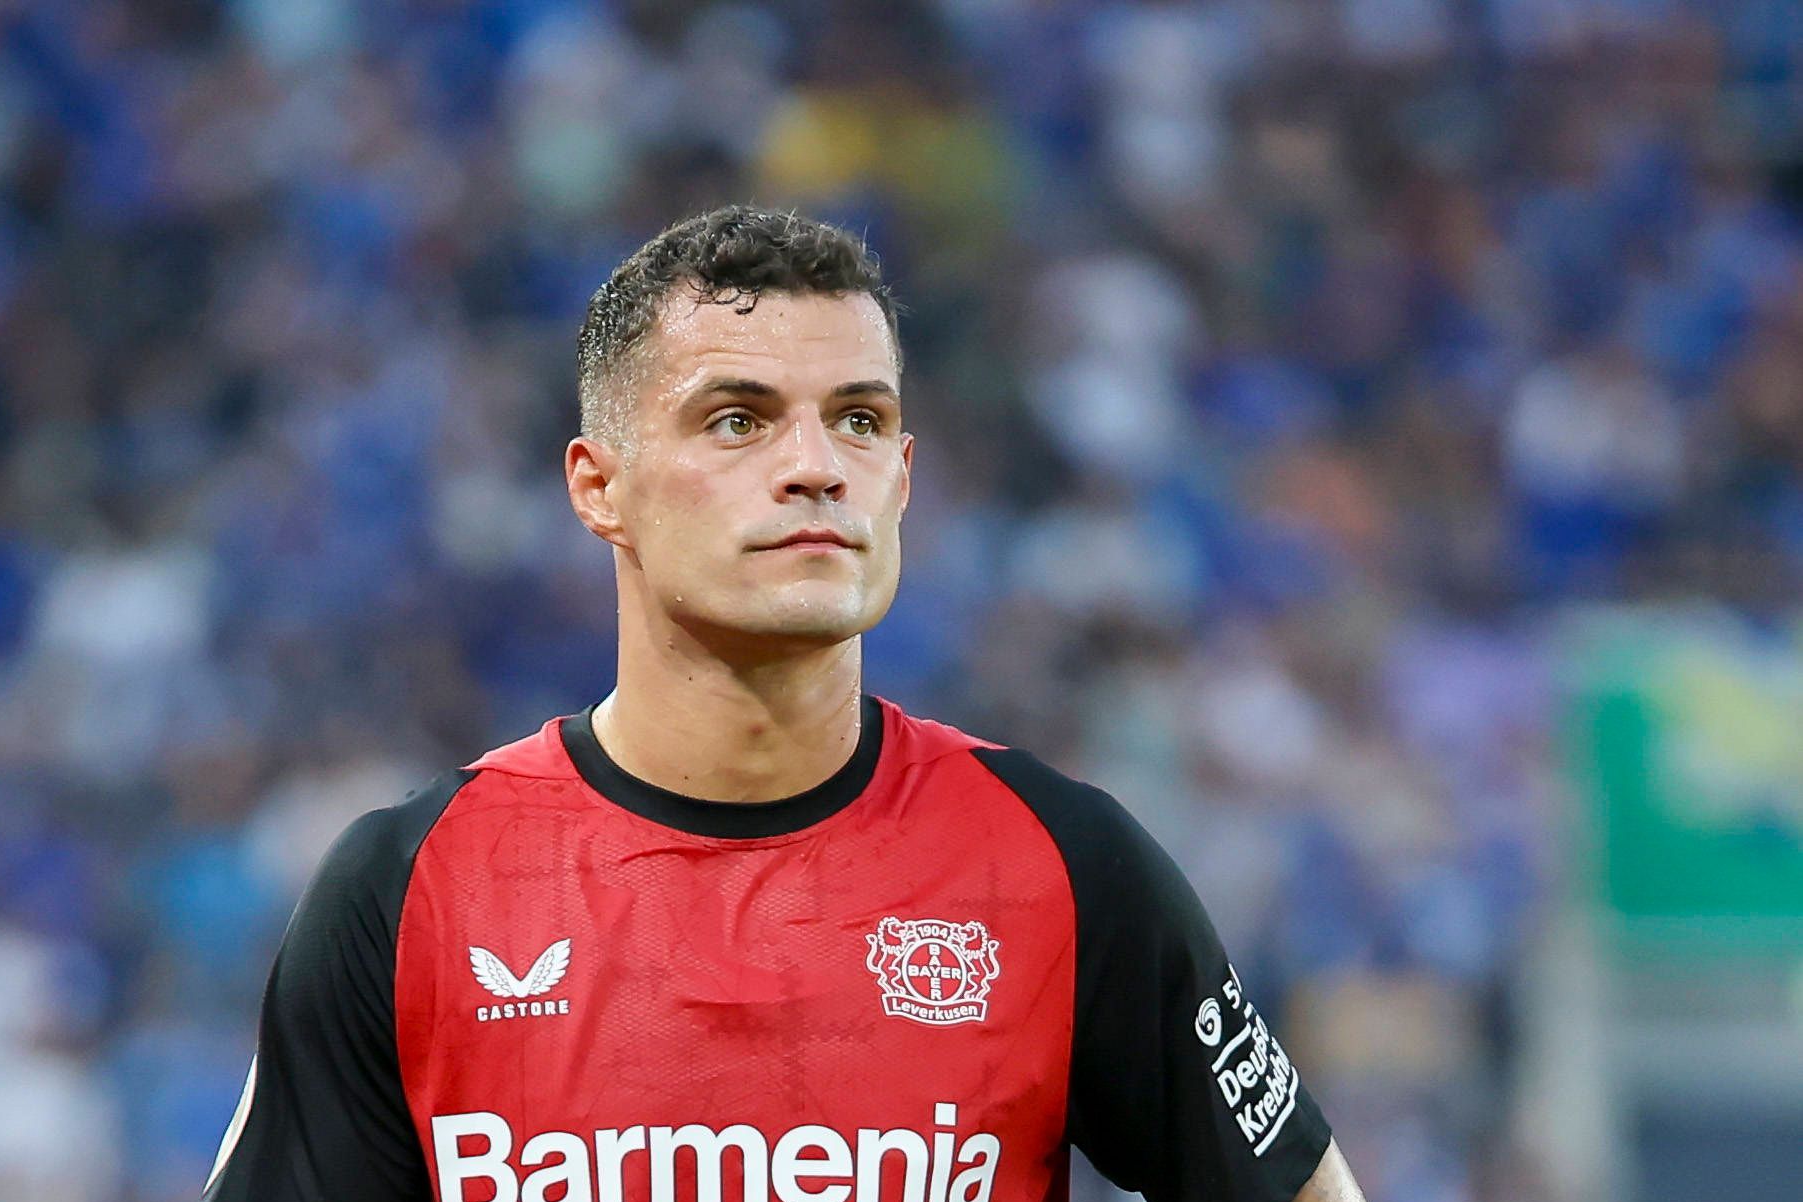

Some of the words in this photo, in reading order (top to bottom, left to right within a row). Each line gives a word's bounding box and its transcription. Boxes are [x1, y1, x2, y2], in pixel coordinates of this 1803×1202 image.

[917, 925, 950, 940] 1904
[907, 965, 963, 979] BAYER
[477, 999, 569, 1022] CASTORE
[892, 998, 979, 1021] Leverkusen
